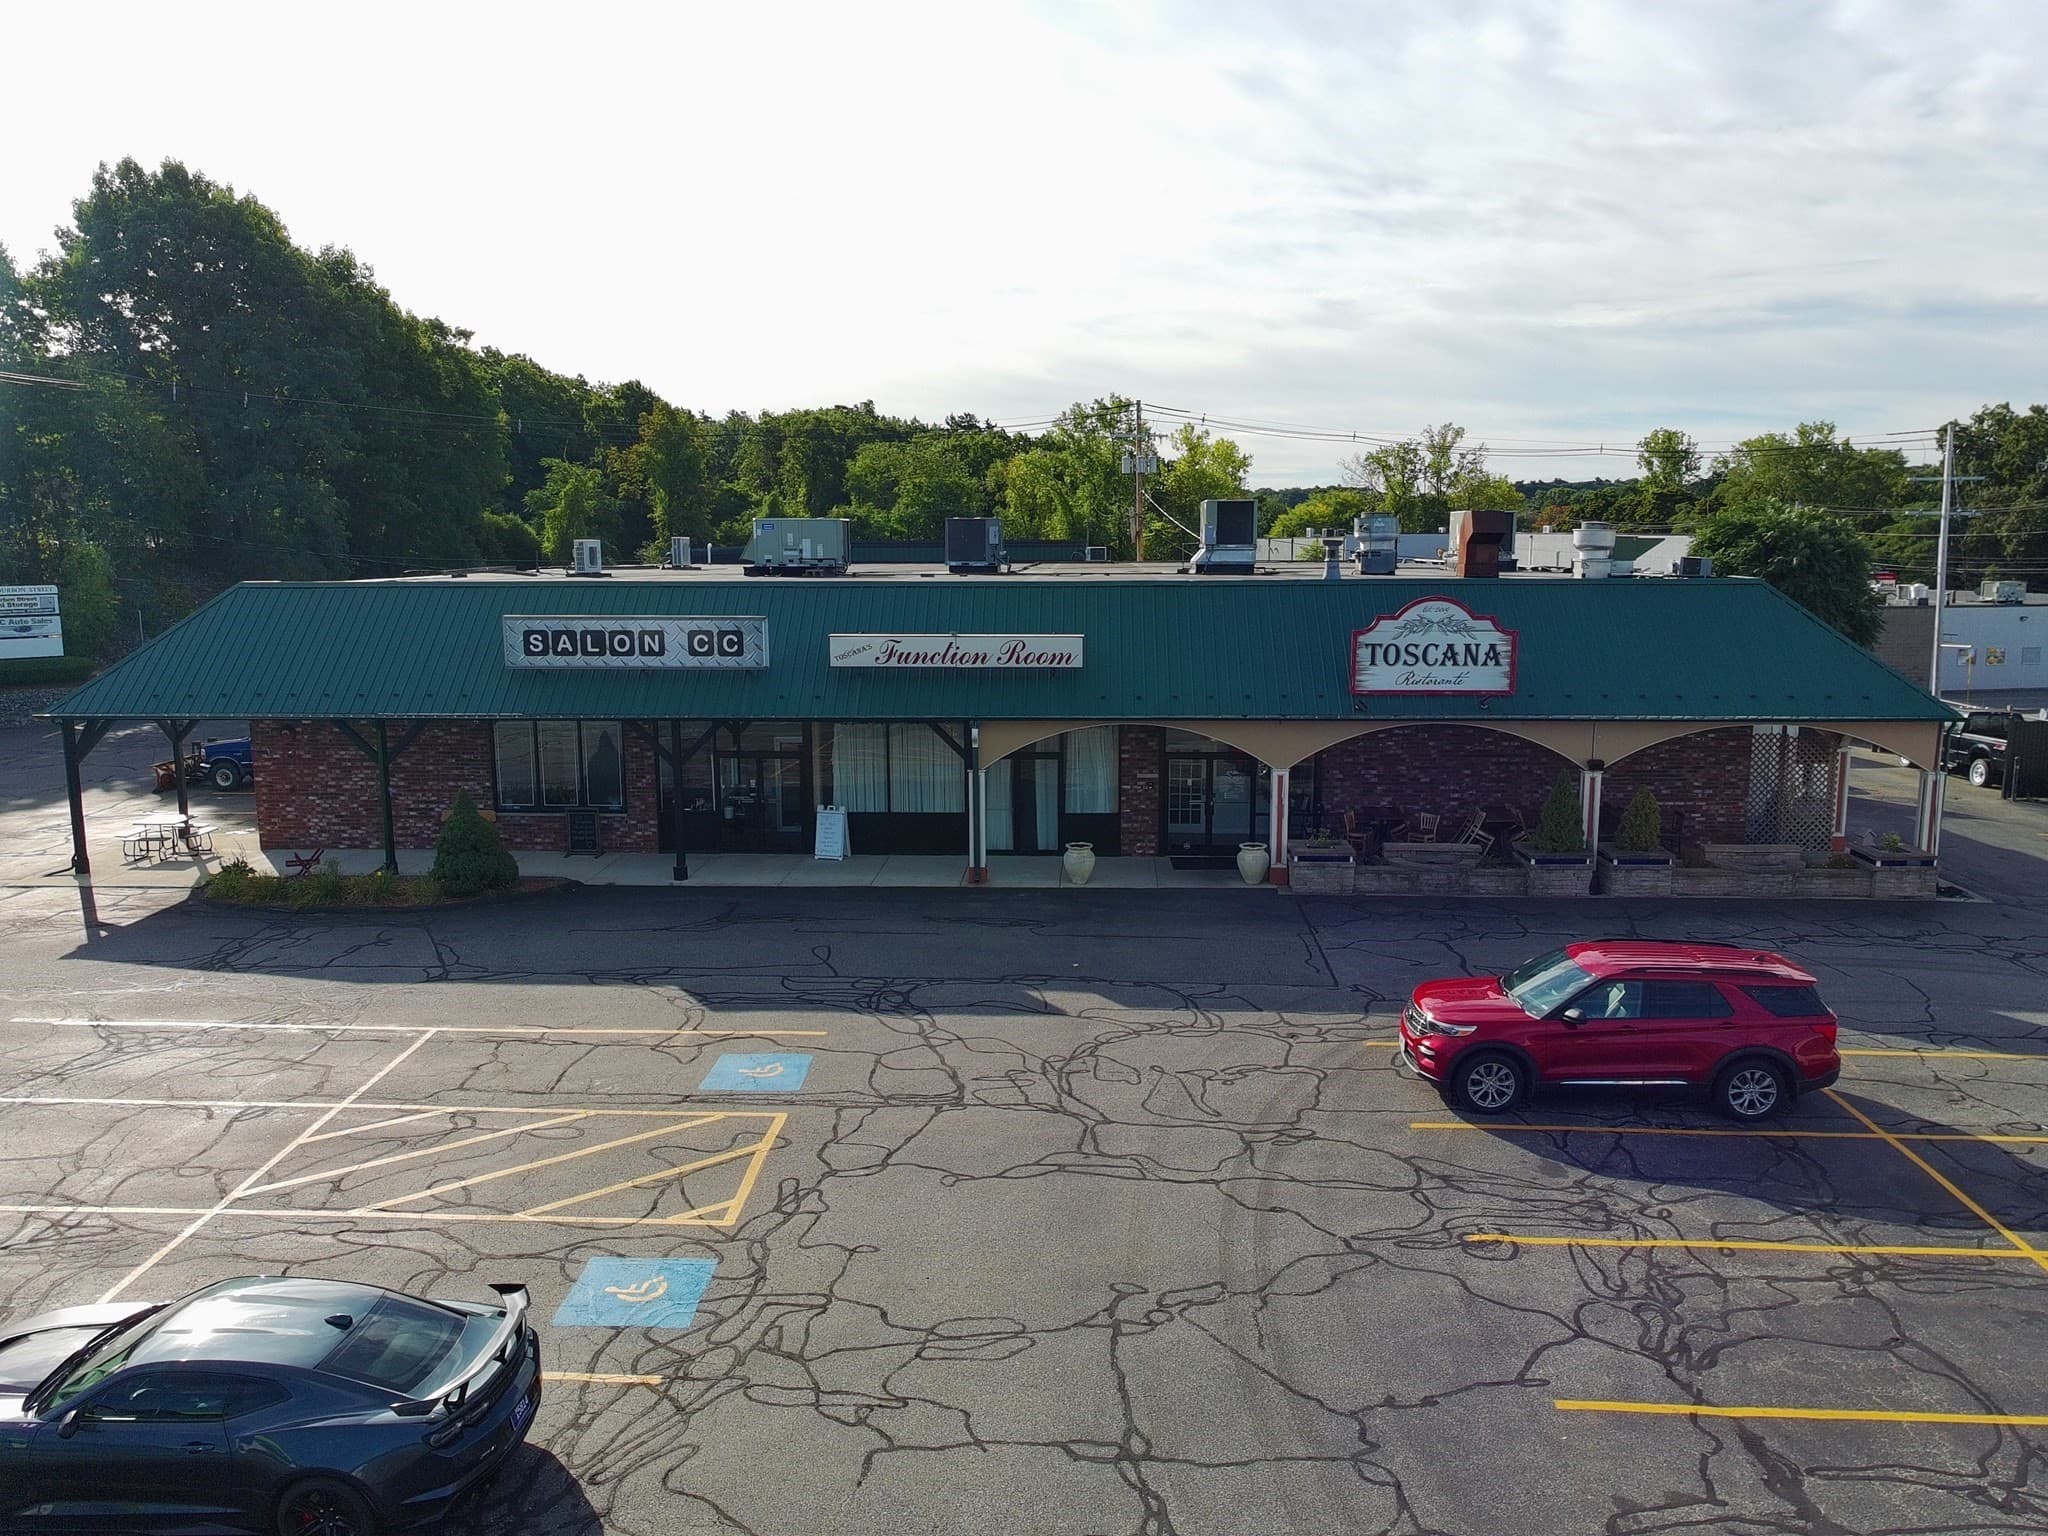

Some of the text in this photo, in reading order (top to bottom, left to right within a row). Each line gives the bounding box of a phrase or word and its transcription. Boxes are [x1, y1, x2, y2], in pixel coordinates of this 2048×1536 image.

[527, 633, 740, 653] SALON CC
[874, 638, 1079, 666] Function Room
[1364, 643, 1503, 668] TOSCANA
